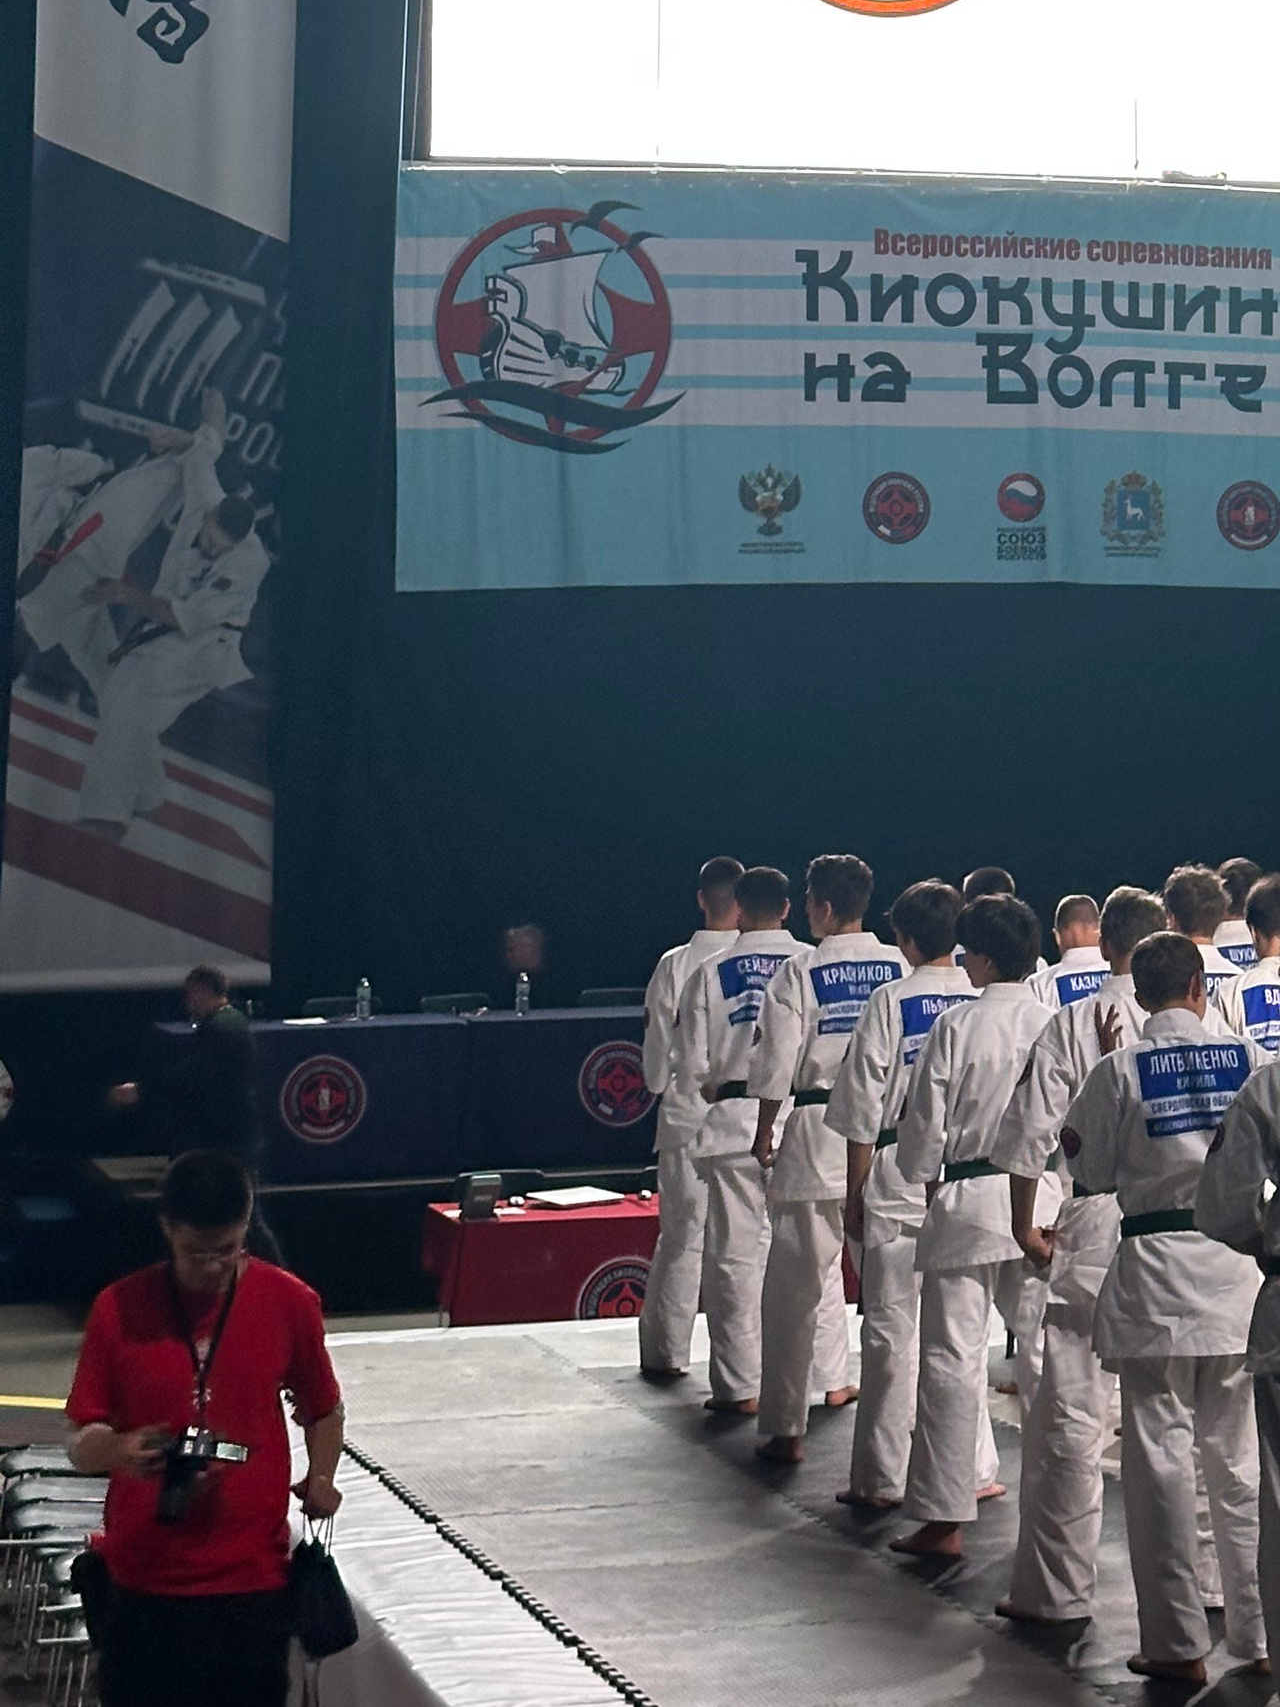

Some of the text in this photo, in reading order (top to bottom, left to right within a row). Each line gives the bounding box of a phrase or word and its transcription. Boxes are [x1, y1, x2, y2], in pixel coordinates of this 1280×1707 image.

[874, 228, 1273, 271] Всероссийские соревнования
[795, 248, 1279, 355] Киокушин
[804, 332, 1267, 414] на Волге
[997, 533, 1046, 545] СОЮЗ
